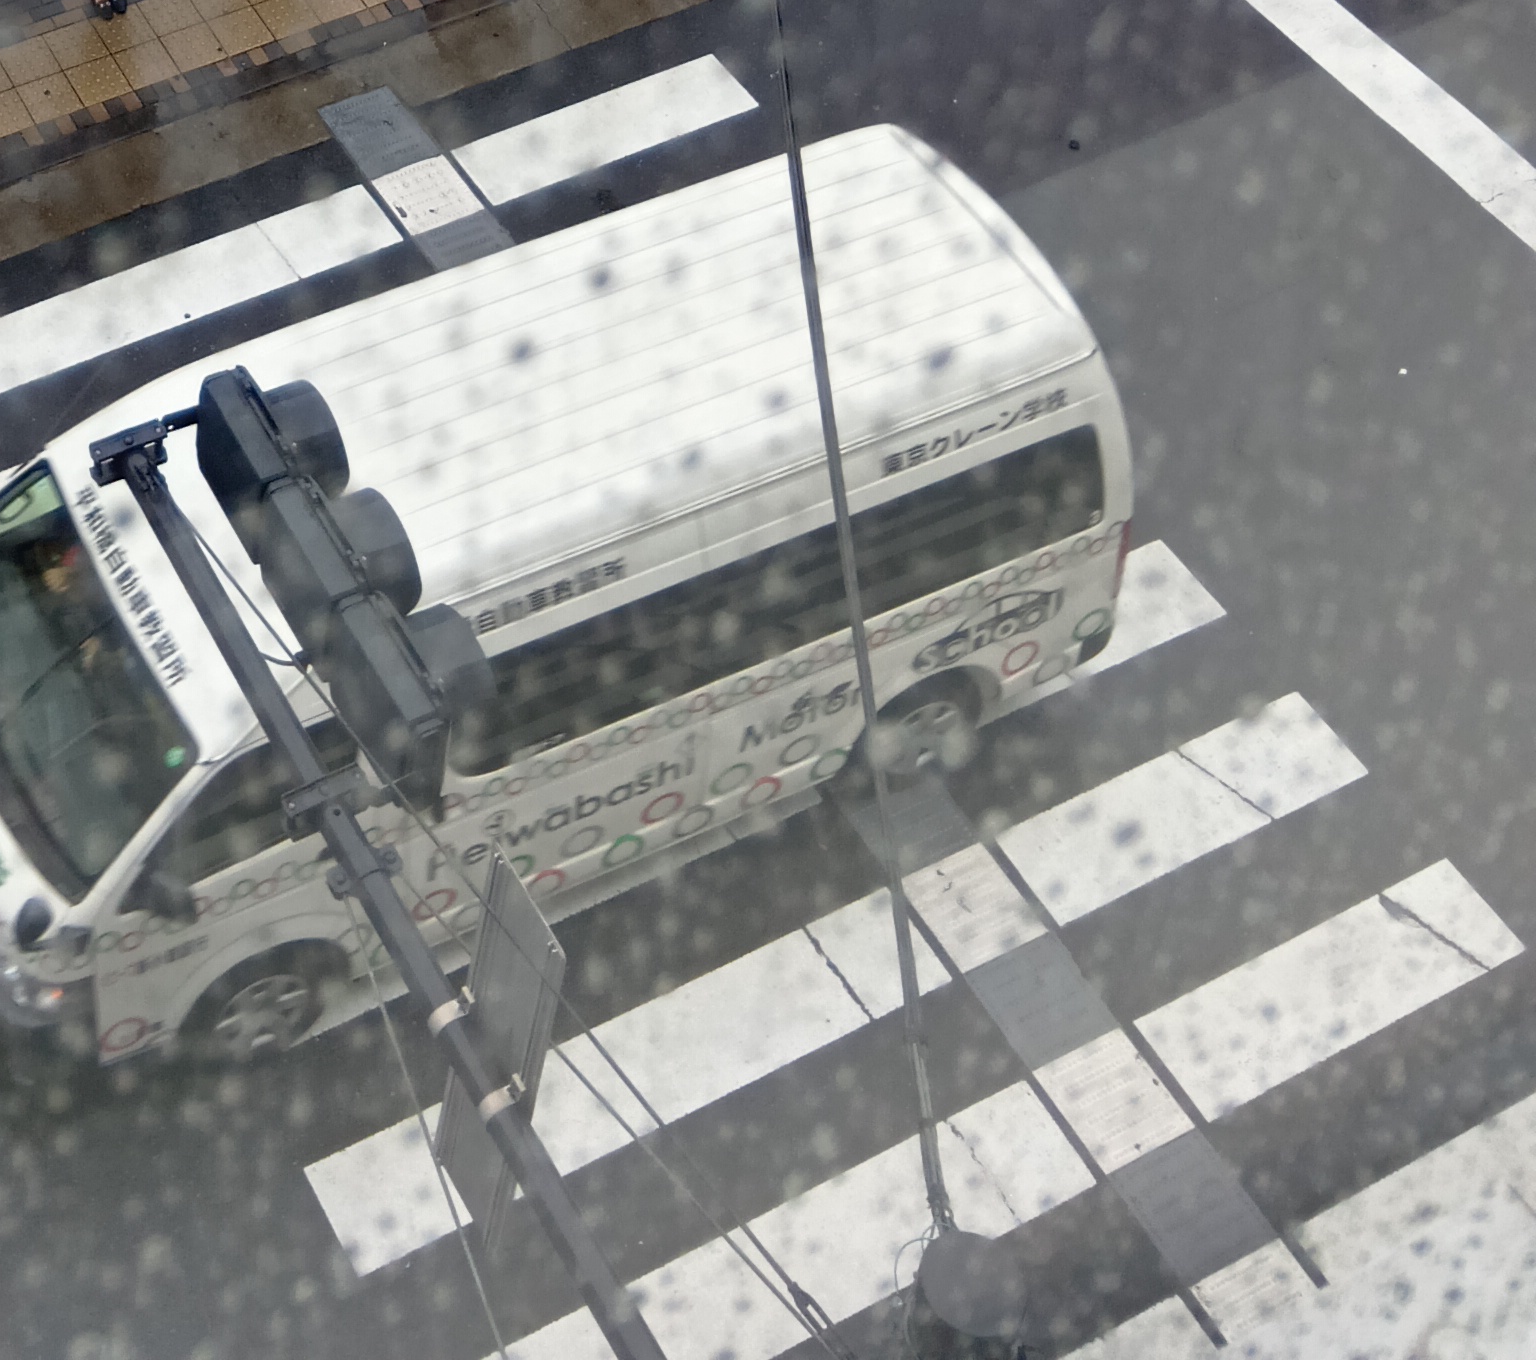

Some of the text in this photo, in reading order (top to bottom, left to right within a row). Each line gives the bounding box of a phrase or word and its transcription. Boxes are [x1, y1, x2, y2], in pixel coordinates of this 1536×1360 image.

[881, 387, 1069, 479] 東京クレーン学校
